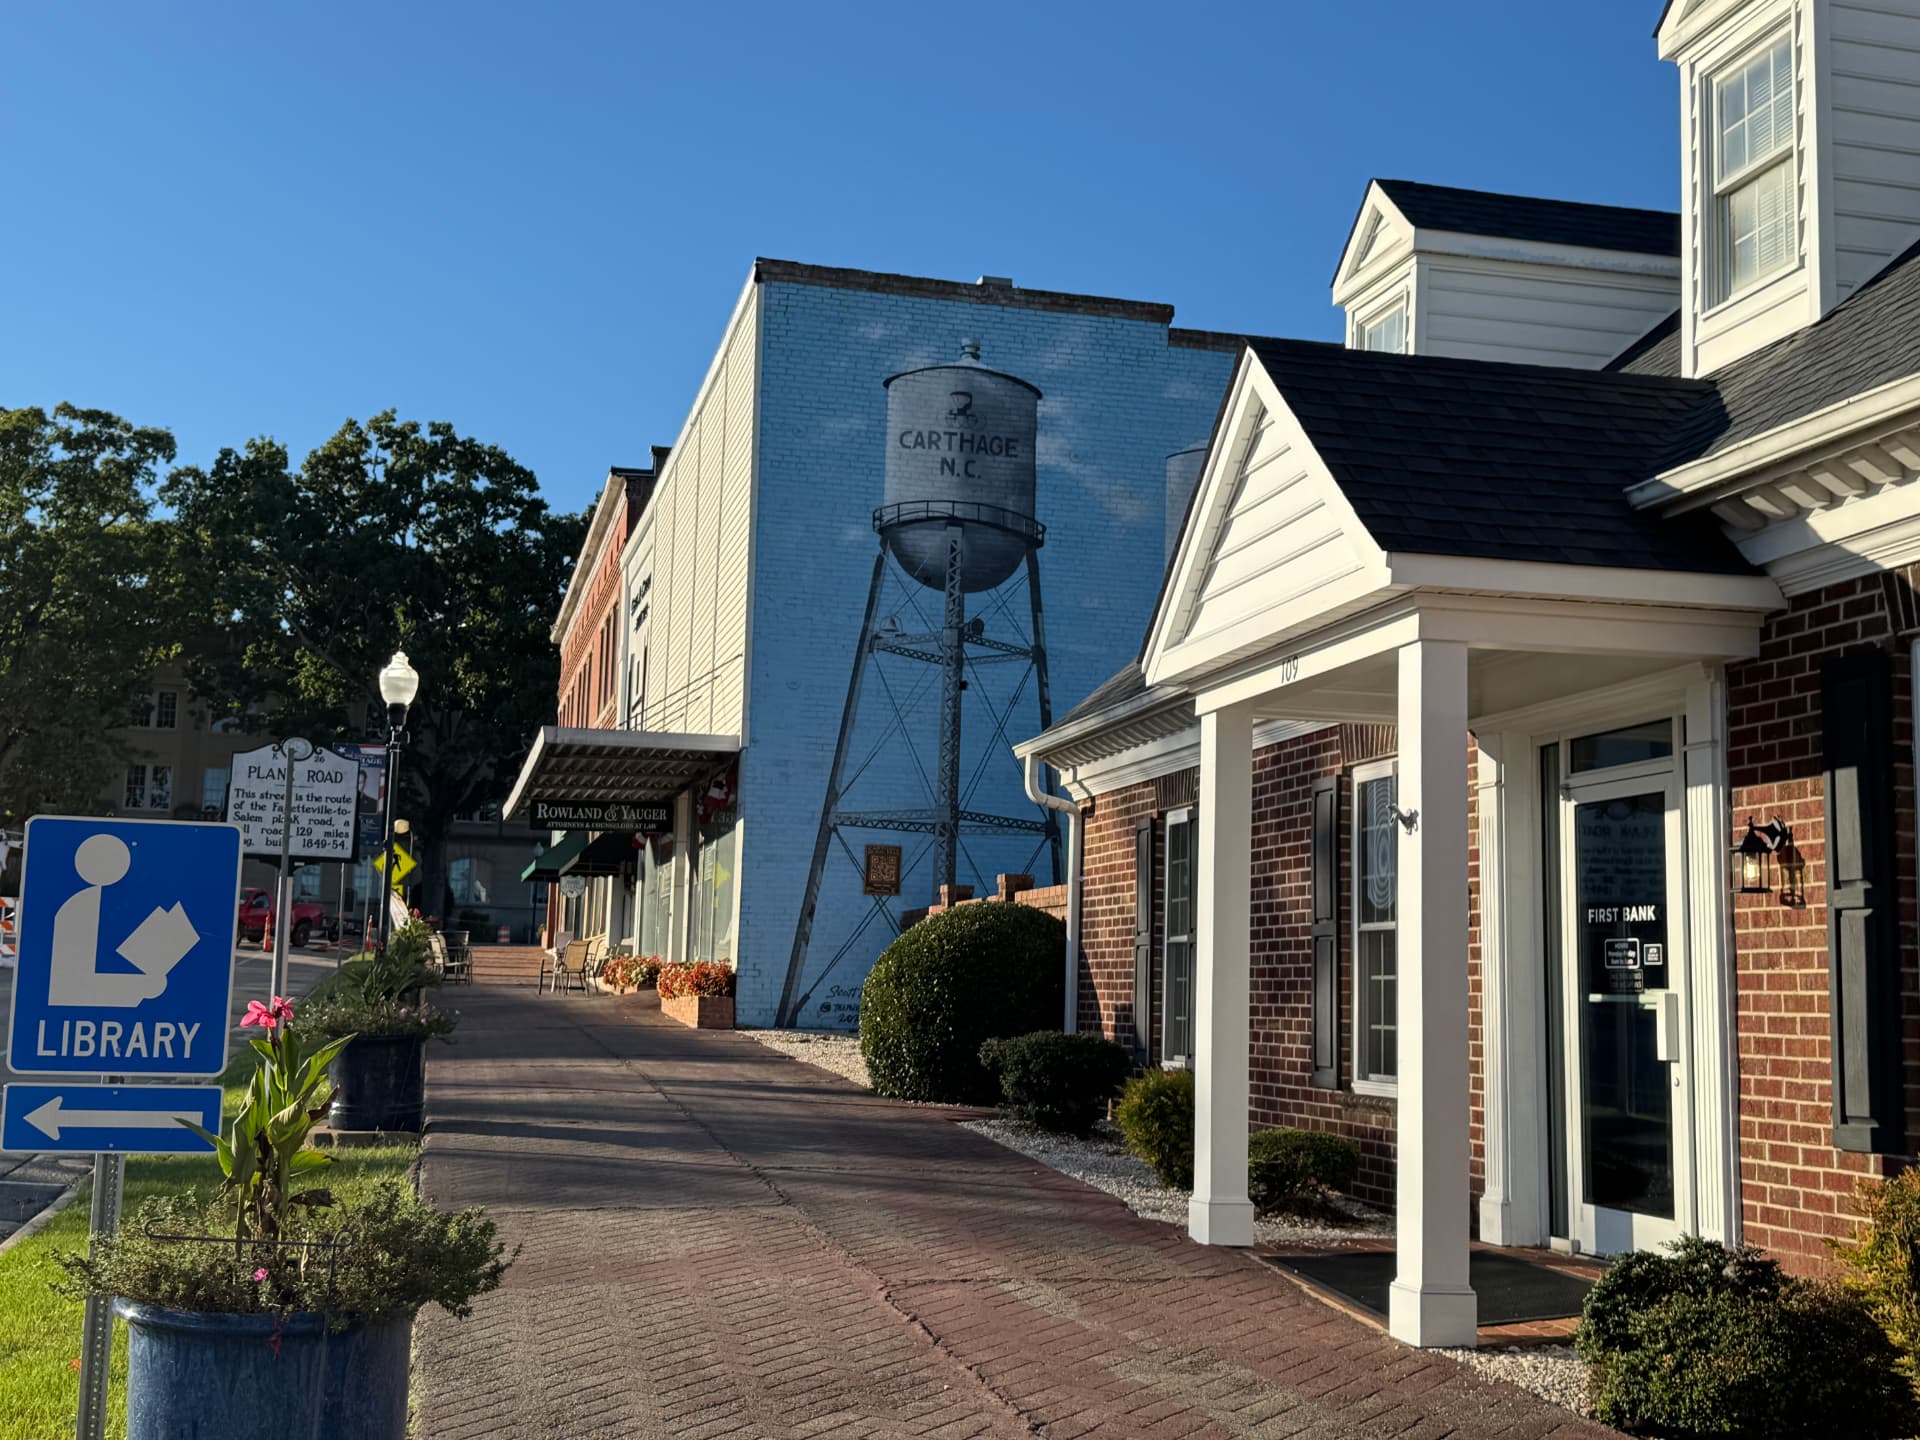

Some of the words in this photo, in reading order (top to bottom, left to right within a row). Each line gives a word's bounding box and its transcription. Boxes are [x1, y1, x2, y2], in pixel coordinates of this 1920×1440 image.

[899, 430, 1019, 458] CARTHAGE
[940, 456, 982, 480] N.C.
[1281, 656, 1298, 684] 109
[248, 765, 294, 781] PLAN
[306, 769, 343, 783] ROAD
[234, 788, 256, 799] This
[259, 790, 285, 800] stree
[295, 793, 303, 801] is
[306, 792, 323, 802] the
[325, 794, 352, 803] route
[233, 800, 245, 810] of
[250, 800, 267, 811] the
[272, 801, 351, 815] Faetteville-to-
[537, 803, 602, 819] ROWLAND
[604, 803, 620, 821] &
[621, 804, 667, 820] YAUGER
[233, 811, 263, 823] Salem
[343, 819, 350, 827] a
[296, 826, 313, 837] 129
[323, 828, 350, 839] miles
[1588, 907, 1619, 924] FIRST
[1623, 905, 1656, 922] BANK
[36, 1019, 201, 1059] LIBRARY
